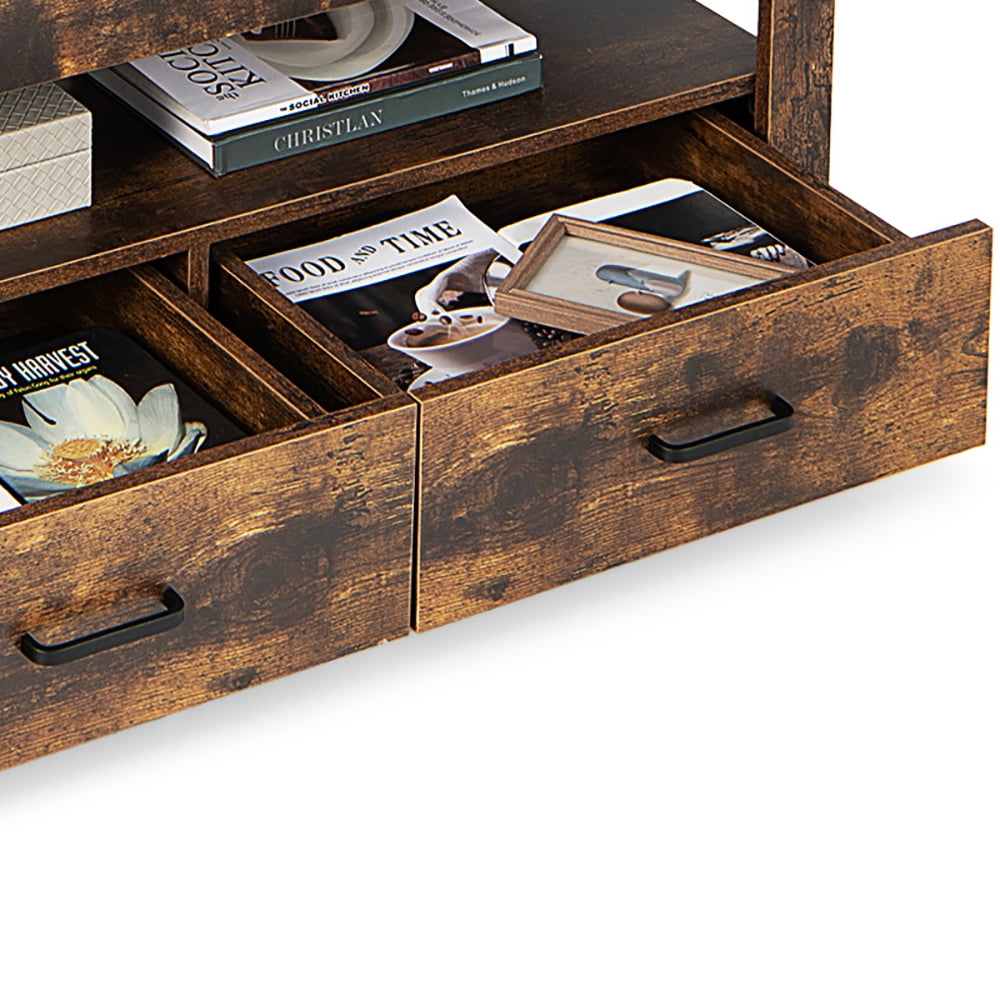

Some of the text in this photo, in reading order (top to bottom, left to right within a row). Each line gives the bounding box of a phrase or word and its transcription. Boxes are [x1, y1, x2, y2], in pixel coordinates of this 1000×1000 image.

[289, 85, 369, 112] SOCIAL KITCHEN
[462, 86, 490, 98] Thames
[498, 76, 526, 88] Hudson
[260, 255, 346, 288] FOOD
[350, 244, 378, 265] AND
[380, 220, 462, 254] TIME
[12, 341, 100, 382] HARVEST
